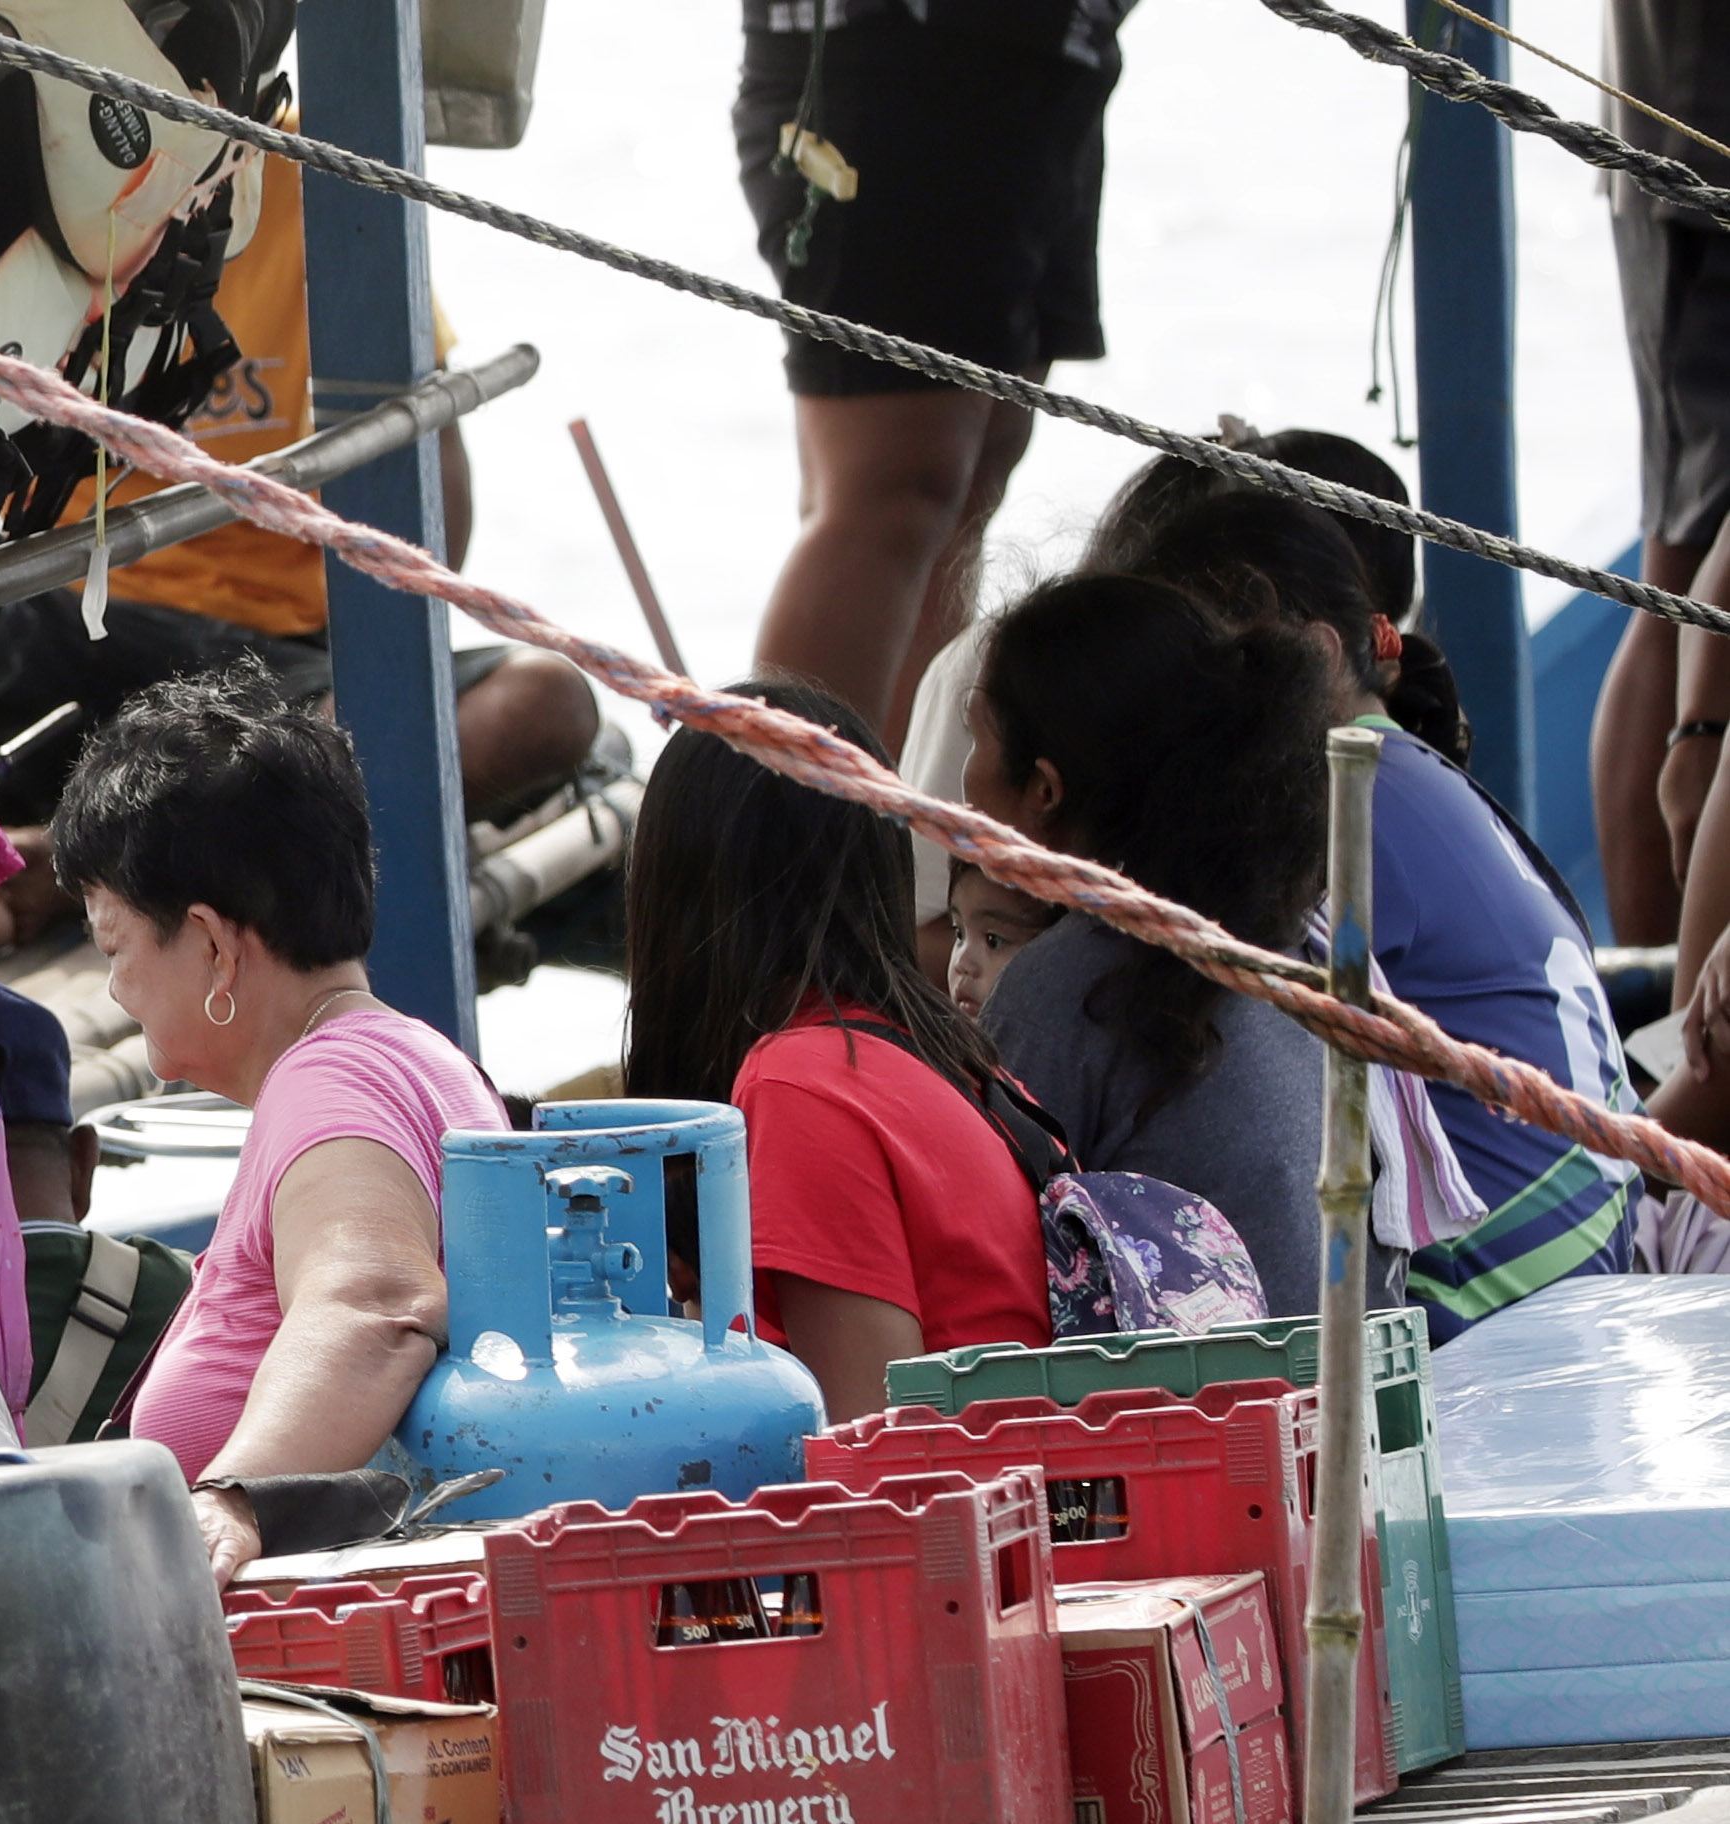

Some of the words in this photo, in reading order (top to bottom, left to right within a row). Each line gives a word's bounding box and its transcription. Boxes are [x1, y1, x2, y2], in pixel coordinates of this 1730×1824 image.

[682, 1624, 711, 1642] 500
[443, 1735, 492, 1759] Content
[600, 1721, 707, 1783] San
[709, 1700, 897, 1780] Miguel
